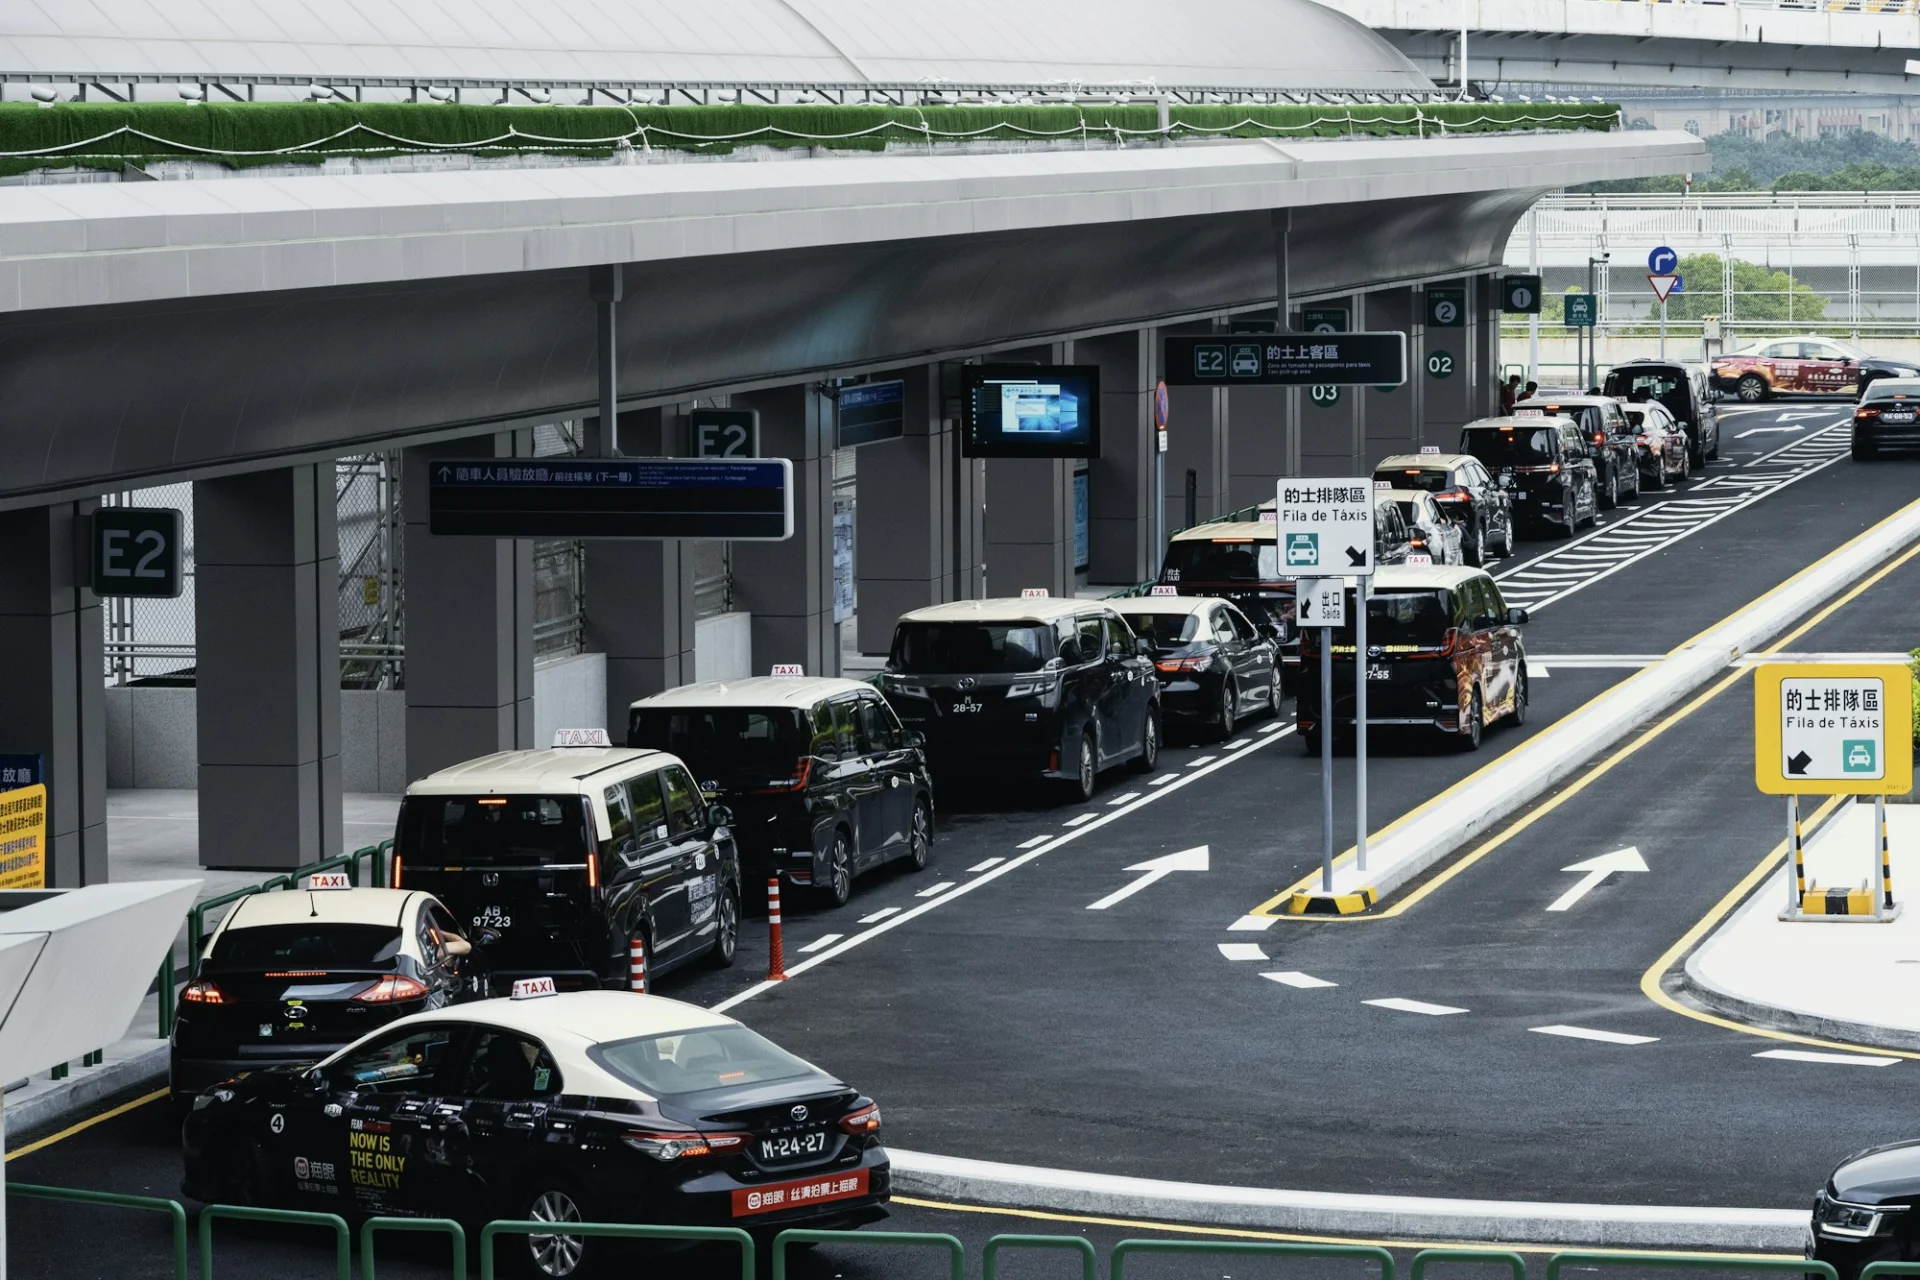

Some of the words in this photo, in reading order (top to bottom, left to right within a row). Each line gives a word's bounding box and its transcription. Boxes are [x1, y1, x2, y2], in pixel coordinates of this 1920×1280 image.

[1440, 304, 1451, 319] 2
[1266, 344, 1339, 360] 的士上客區
[1197, 351, 1224, 371] E2
[1428, 356, 1452, 373] 02
[1311, 386, 1337, 401] 03
[698, 424, 747, 458] E2
[1284, 487, 1366, 504] 的士排隊區
[1283, 509, 1307, 522] Fila
[1312, 509, 1327, 522] de
[1332, 509, 1368, 522] Táxis
[101, 529, 167, 579] E2
[1023, 589, 1046, 597] TAXI
[1153, 586, 1174, 594] TAXI
[1321, 591, 1340, 607] 出口
[773, 666, 799, 675] TAXI
[1372, 663, 1379, 671] M
[964, 695, 972, 704] M
[1786, 688, 1879, 712] 的士排隊區
[953, 703, 983, 713] 28-57
[1786, 716, 1815, 728] Fila
[1819, 716, 1835, 728] de
[1840, 715, 1879, 728] Táxis
[557, 730, 604, 744] TAXI
[311, 875, 345, 887] TAXI
[483, 905, 501, 916] AB
[472, 916, 512, 927] 97-23
[522, 979, 553, 995] TAXI
[272, 1115, 282, 1131] 4
[350, 1118, 363, 1131] FEAR
[770, 1120, 828, 1134] CAMRY
[350, 1131, 377, 1150] NOW
[379, 1136, 391, 1152] IS
[761, 1131, 826, 1159] M-24-27
[350, 1150, 374, 1168] THE
[375, 1154, 406, 1173] ONLY
[310, 1161, 336, 1180] 猫眼
[350, 1168, 400, 1189] REALITY
[762, 1189, 785, 1206] 猫眼
